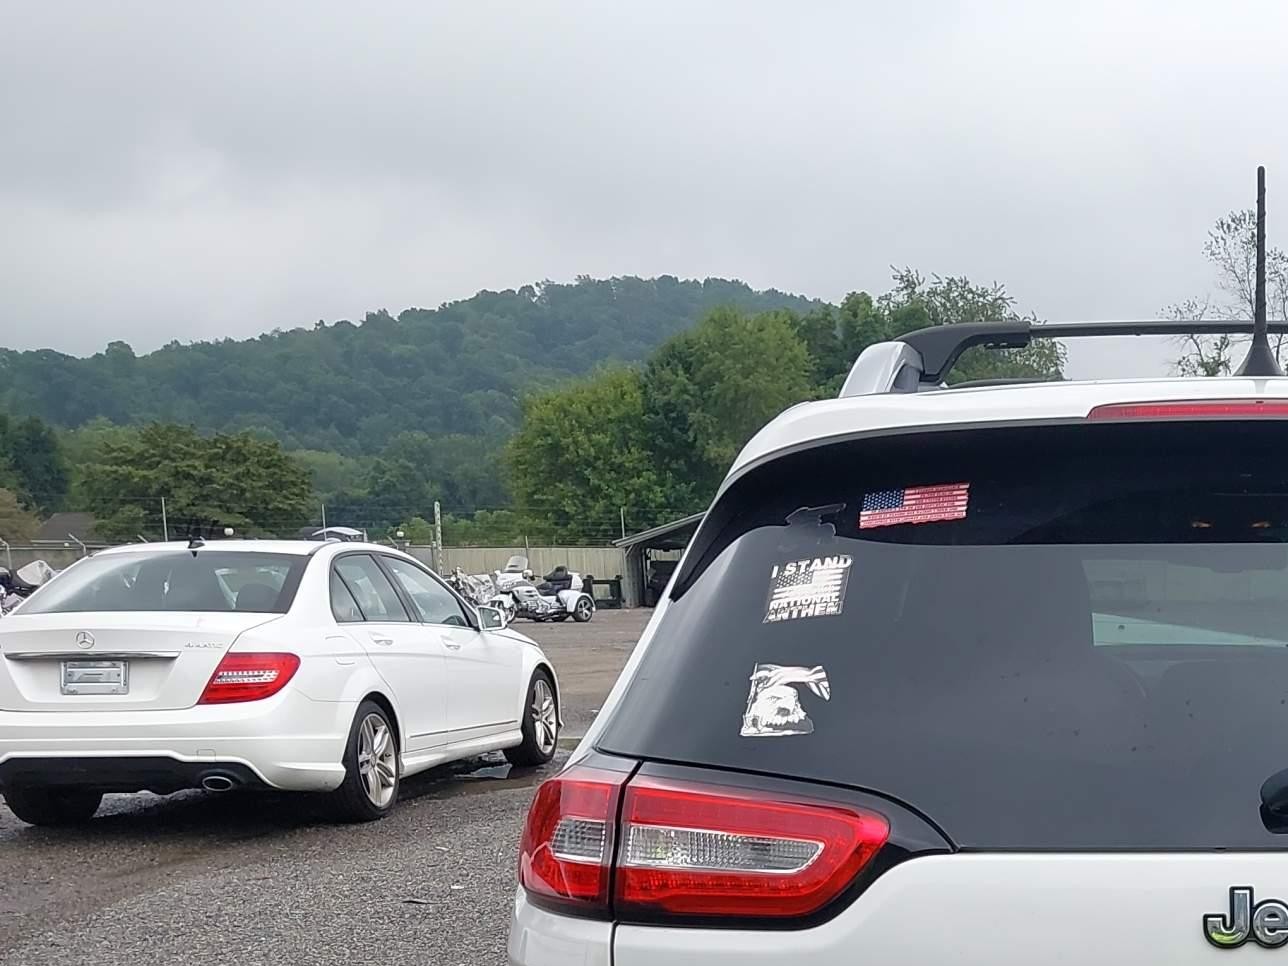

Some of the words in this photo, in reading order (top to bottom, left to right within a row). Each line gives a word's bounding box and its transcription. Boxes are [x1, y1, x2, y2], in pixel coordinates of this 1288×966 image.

[771, 565, 779, 579] I
[783, 555, 853, 576] STAND
[769, 592, 840, 610] NATIONAL
[767, 602, 842, 621] ANTHEM
